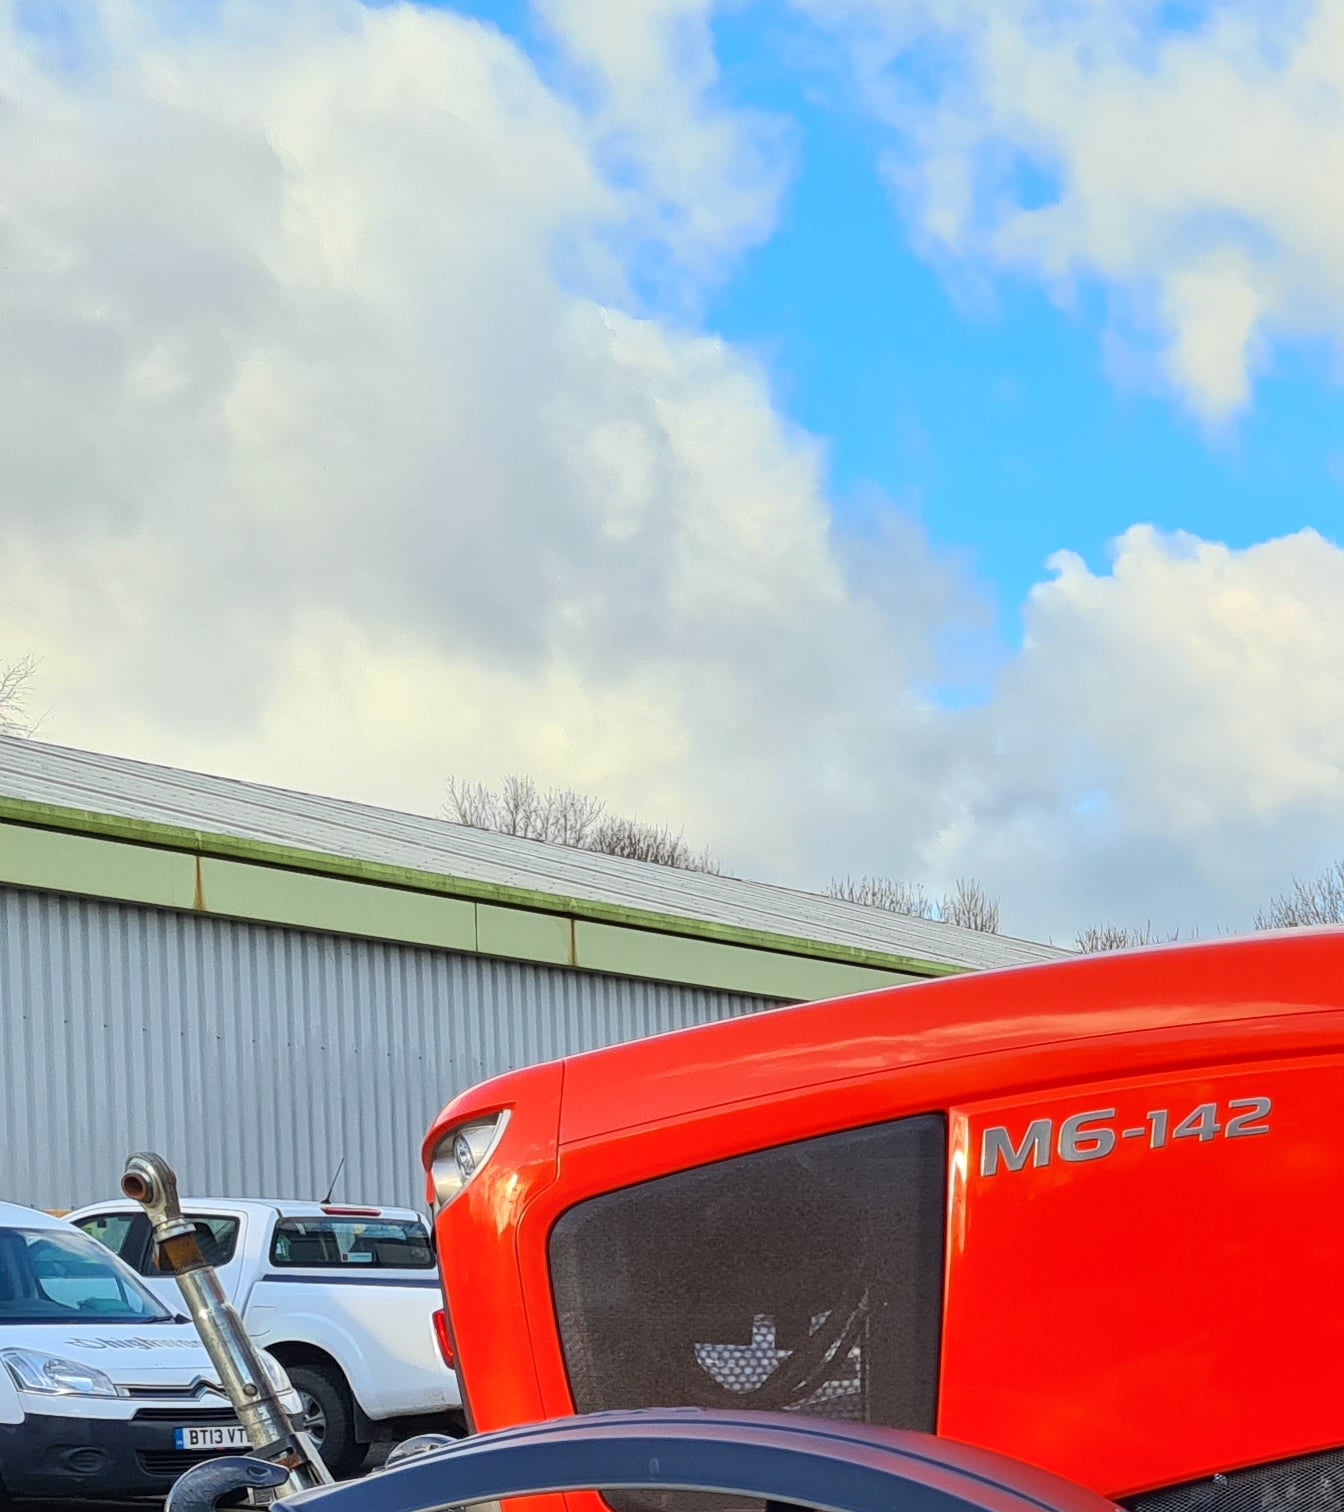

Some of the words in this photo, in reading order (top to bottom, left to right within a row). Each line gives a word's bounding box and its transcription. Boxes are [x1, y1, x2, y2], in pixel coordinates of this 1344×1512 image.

[979, 1096, 1273, 1178] M6-142
[189, 1429, 223, 1445] BT13
[227, 1428, 253, 1444] VT
